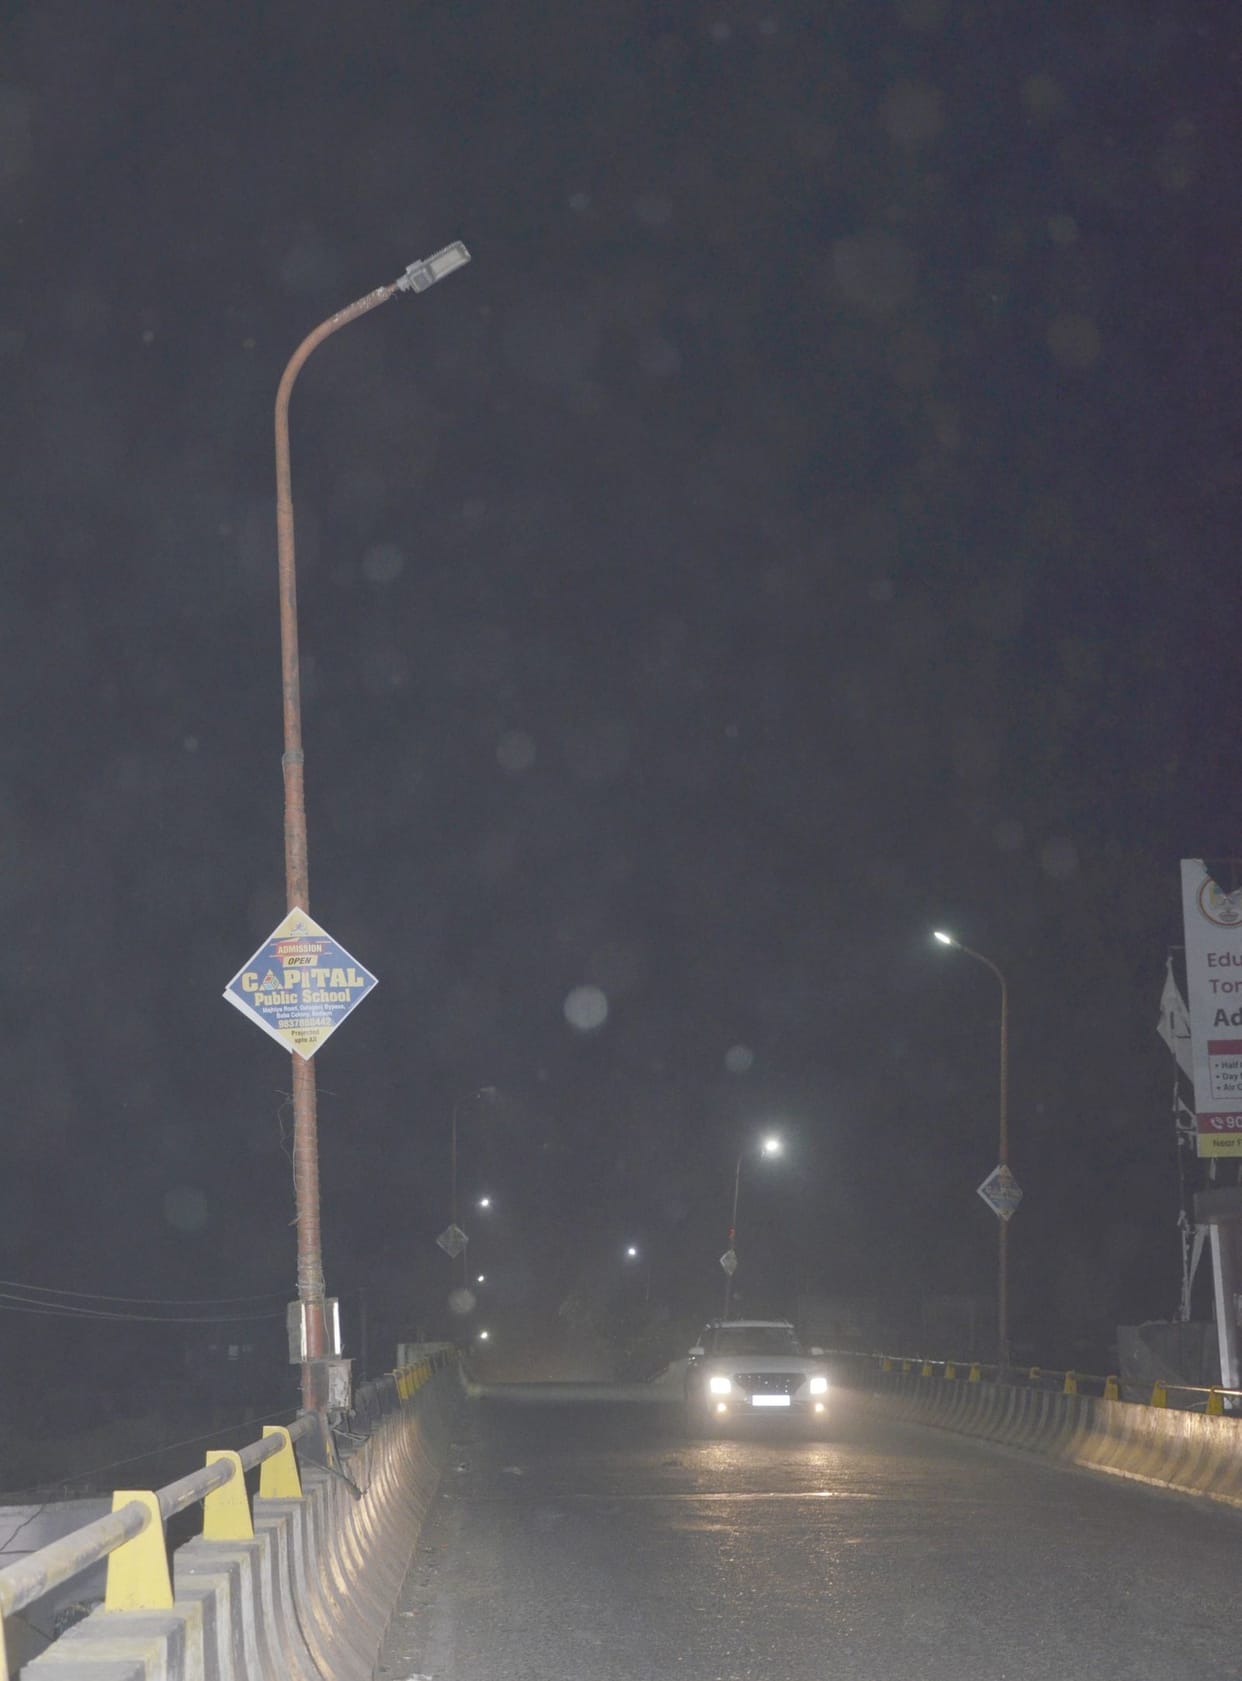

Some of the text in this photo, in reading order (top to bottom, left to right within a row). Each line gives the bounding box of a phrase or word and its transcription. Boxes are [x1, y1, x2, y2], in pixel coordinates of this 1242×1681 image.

[278, 944, 322, 953] ADMISSION
[288, 957, 312, 965] OPEN
[254, 989, 351, 1006] Public School
[1222, 1073, 1238, 1081] Day
[1223, 1083, 1235, 1091] Air
